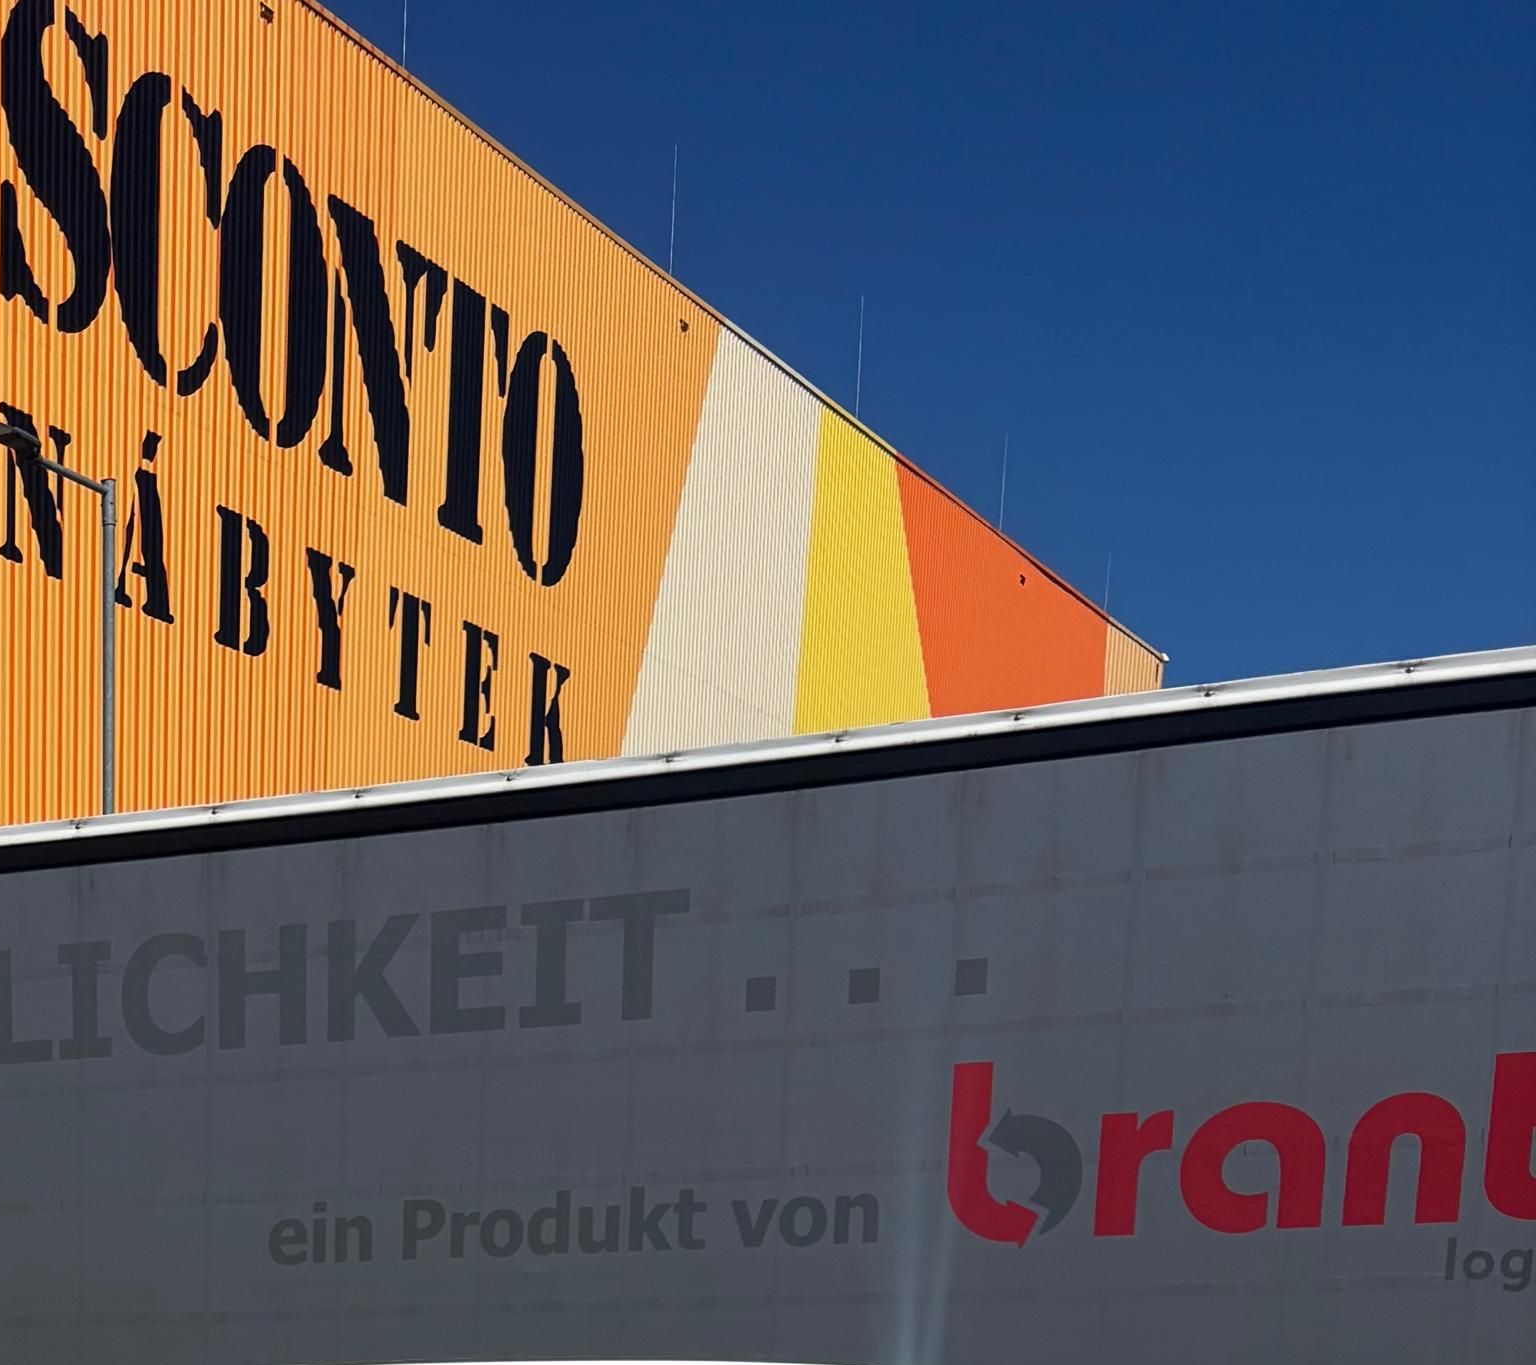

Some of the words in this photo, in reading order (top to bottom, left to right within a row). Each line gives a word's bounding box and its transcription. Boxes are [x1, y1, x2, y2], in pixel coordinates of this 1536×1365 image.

[0, 0, 584, 587] SCONTO
[267, 1199, 374, 1266] ein
[400, 1187, 707, 1262] Produkt
[740, 1191, 880, 1250] von
